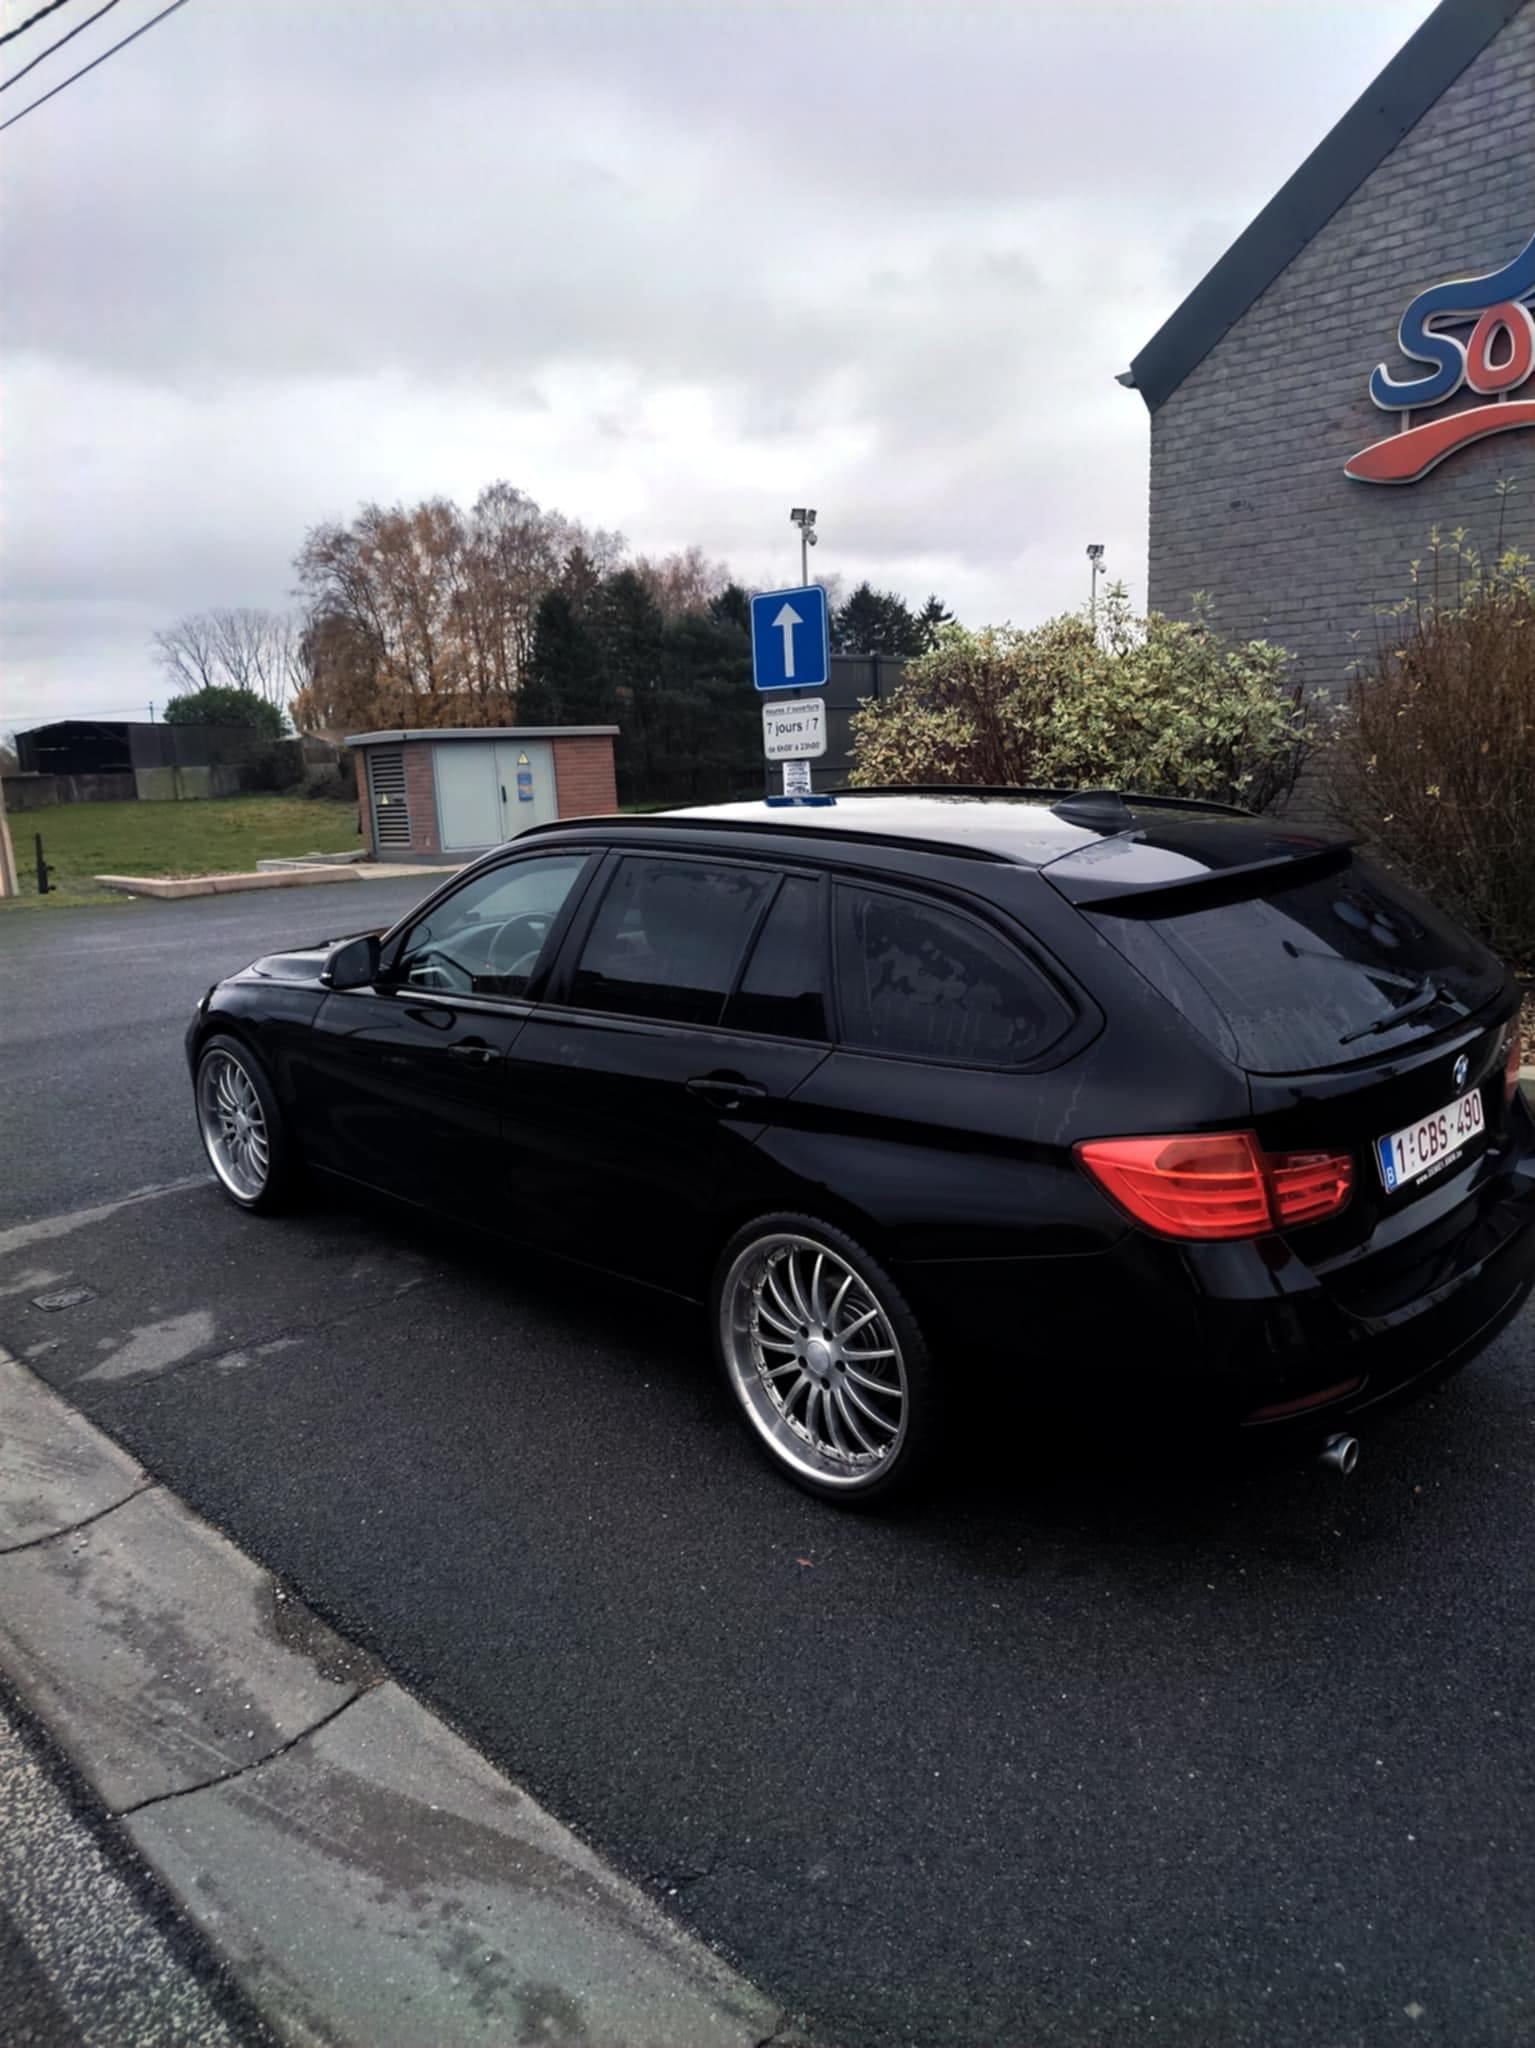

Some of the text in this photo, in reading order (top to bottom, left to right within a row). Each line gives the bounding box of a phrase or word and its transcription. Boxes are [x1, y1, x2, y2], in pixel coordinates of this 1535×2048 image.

[767, 722, 773, 734] 7
[776, 721, 802, 737] jours
[812, 718, 819, 731] 7
[1387, 1167, 1395, 1185] B
